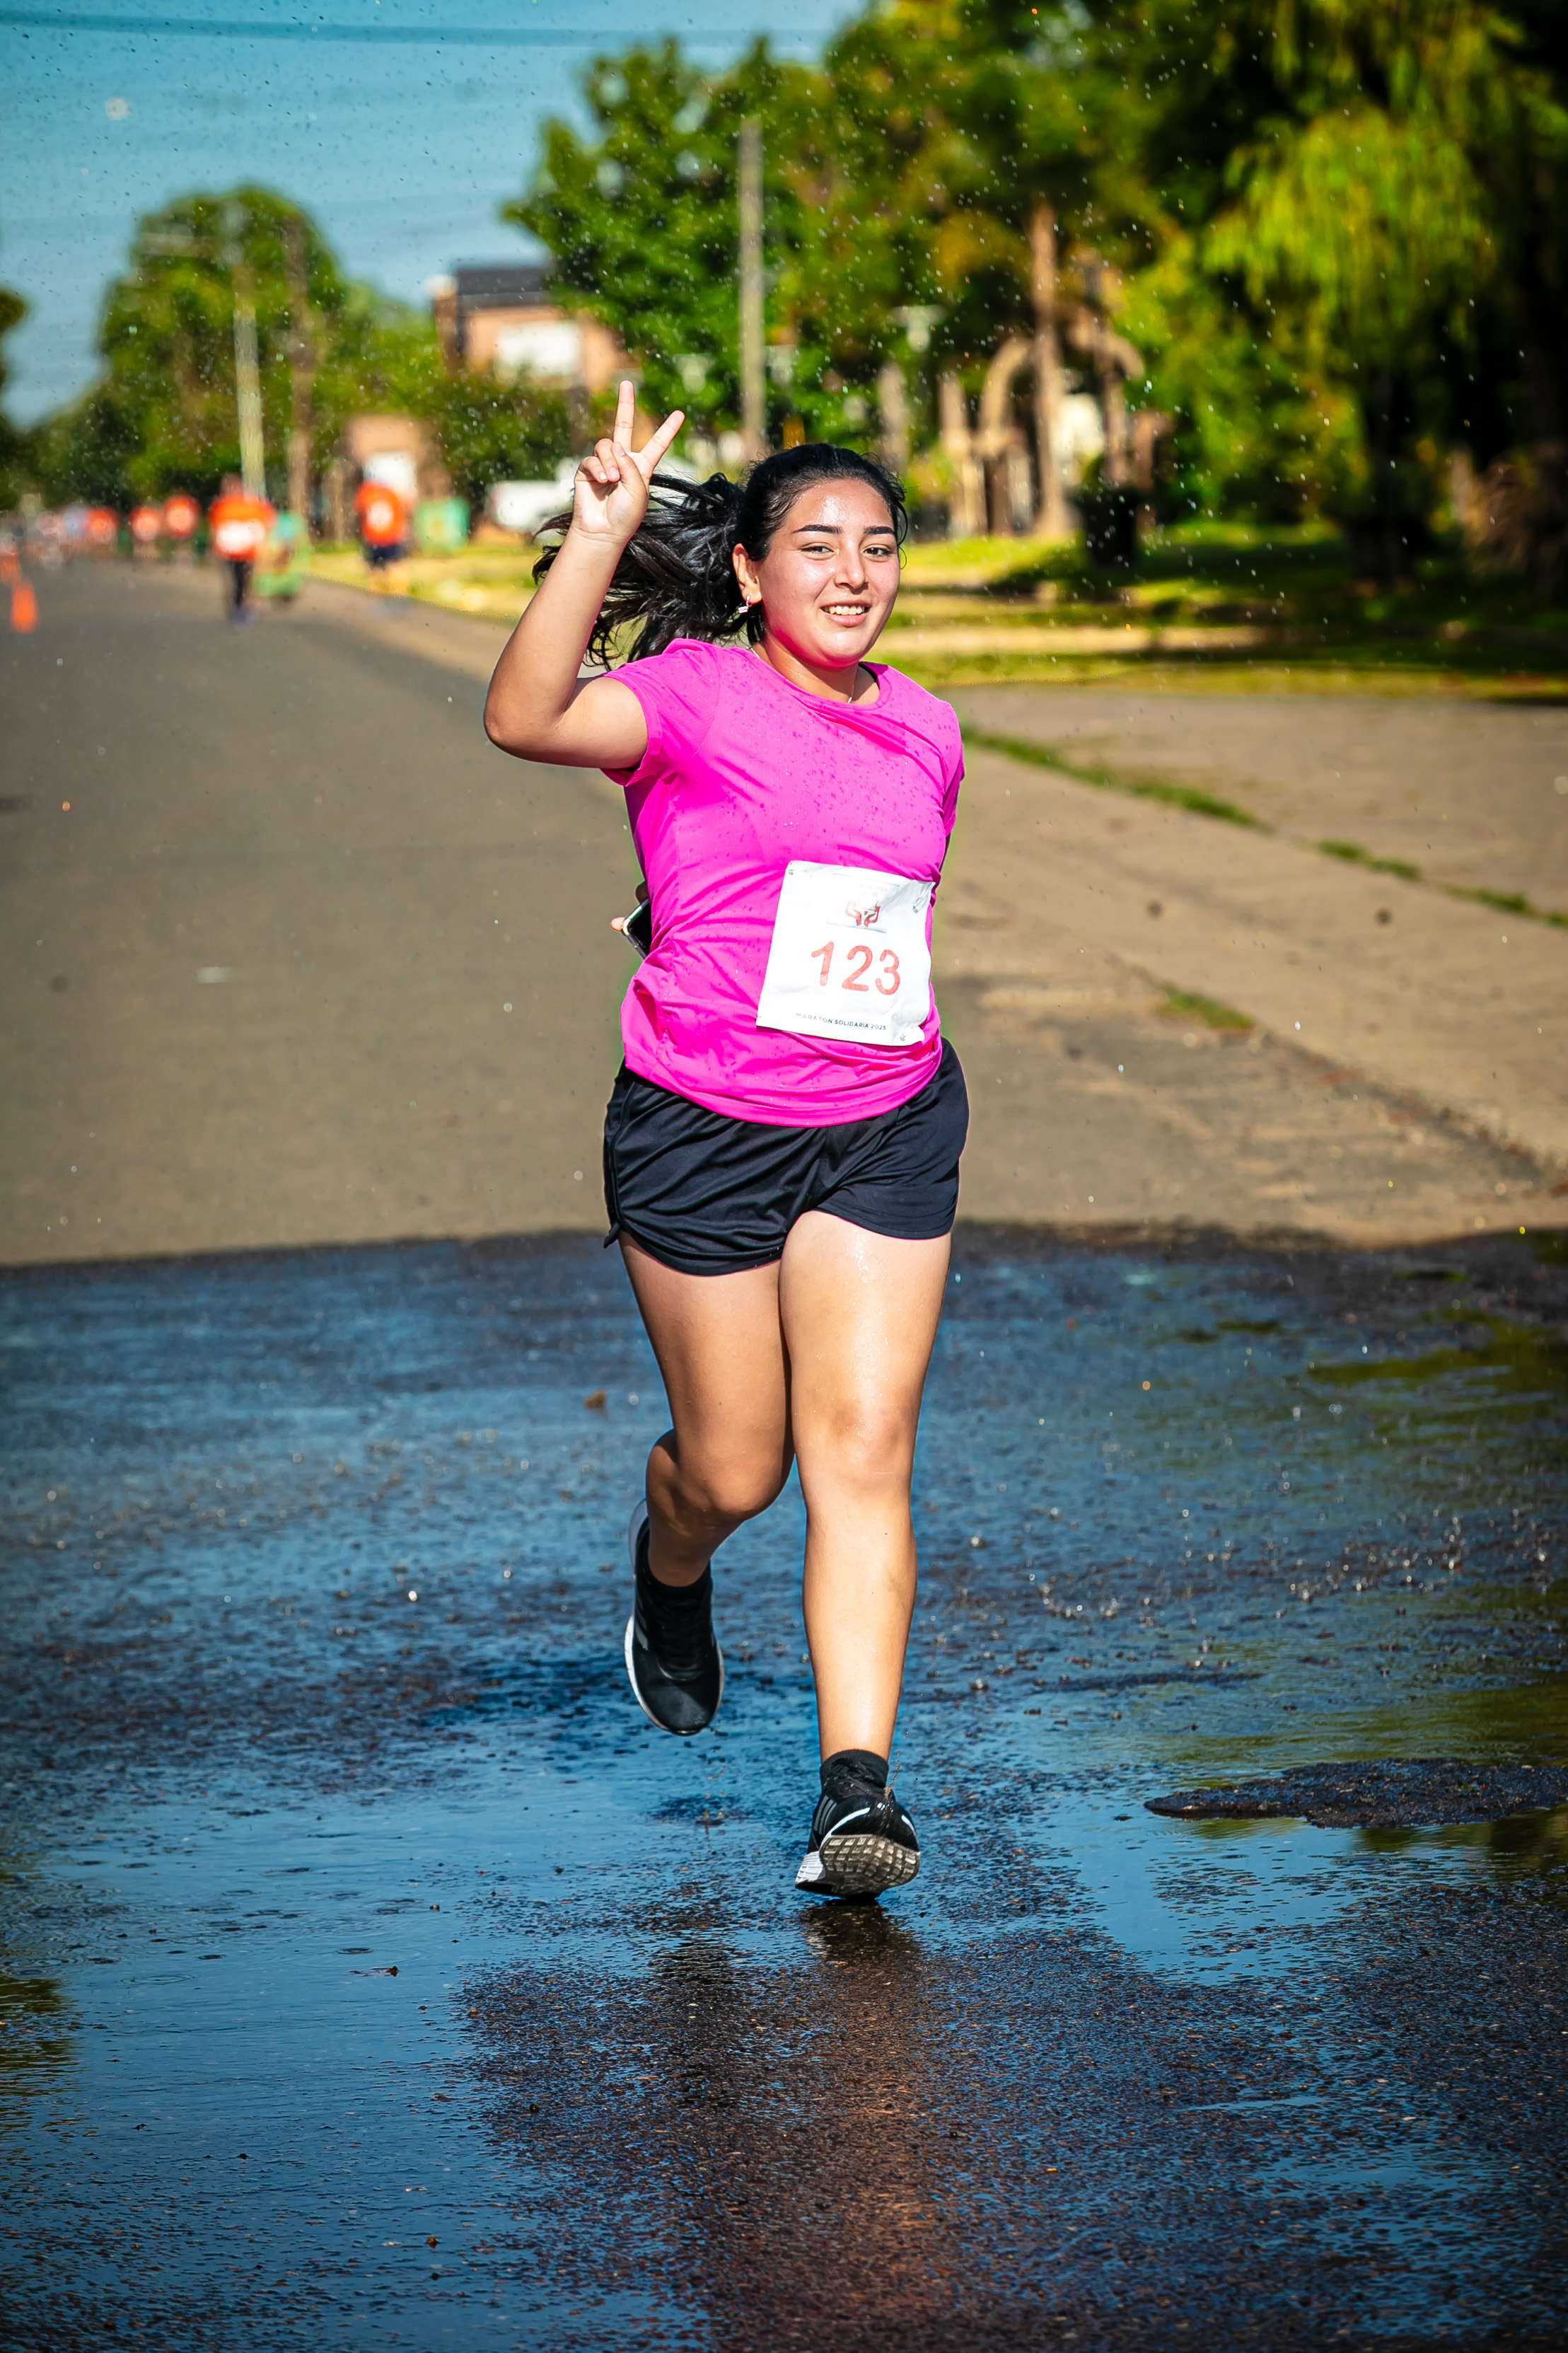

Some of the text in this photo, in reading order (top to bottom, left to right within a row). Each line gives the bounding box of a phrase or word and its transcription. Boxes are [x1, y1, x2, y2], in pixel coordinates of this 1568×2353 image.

[811, 941, 900, 995] 123
[796, 1012, 832, 1024] MARATON
[835, 1019, 869, 1028] SOLIDARIA
